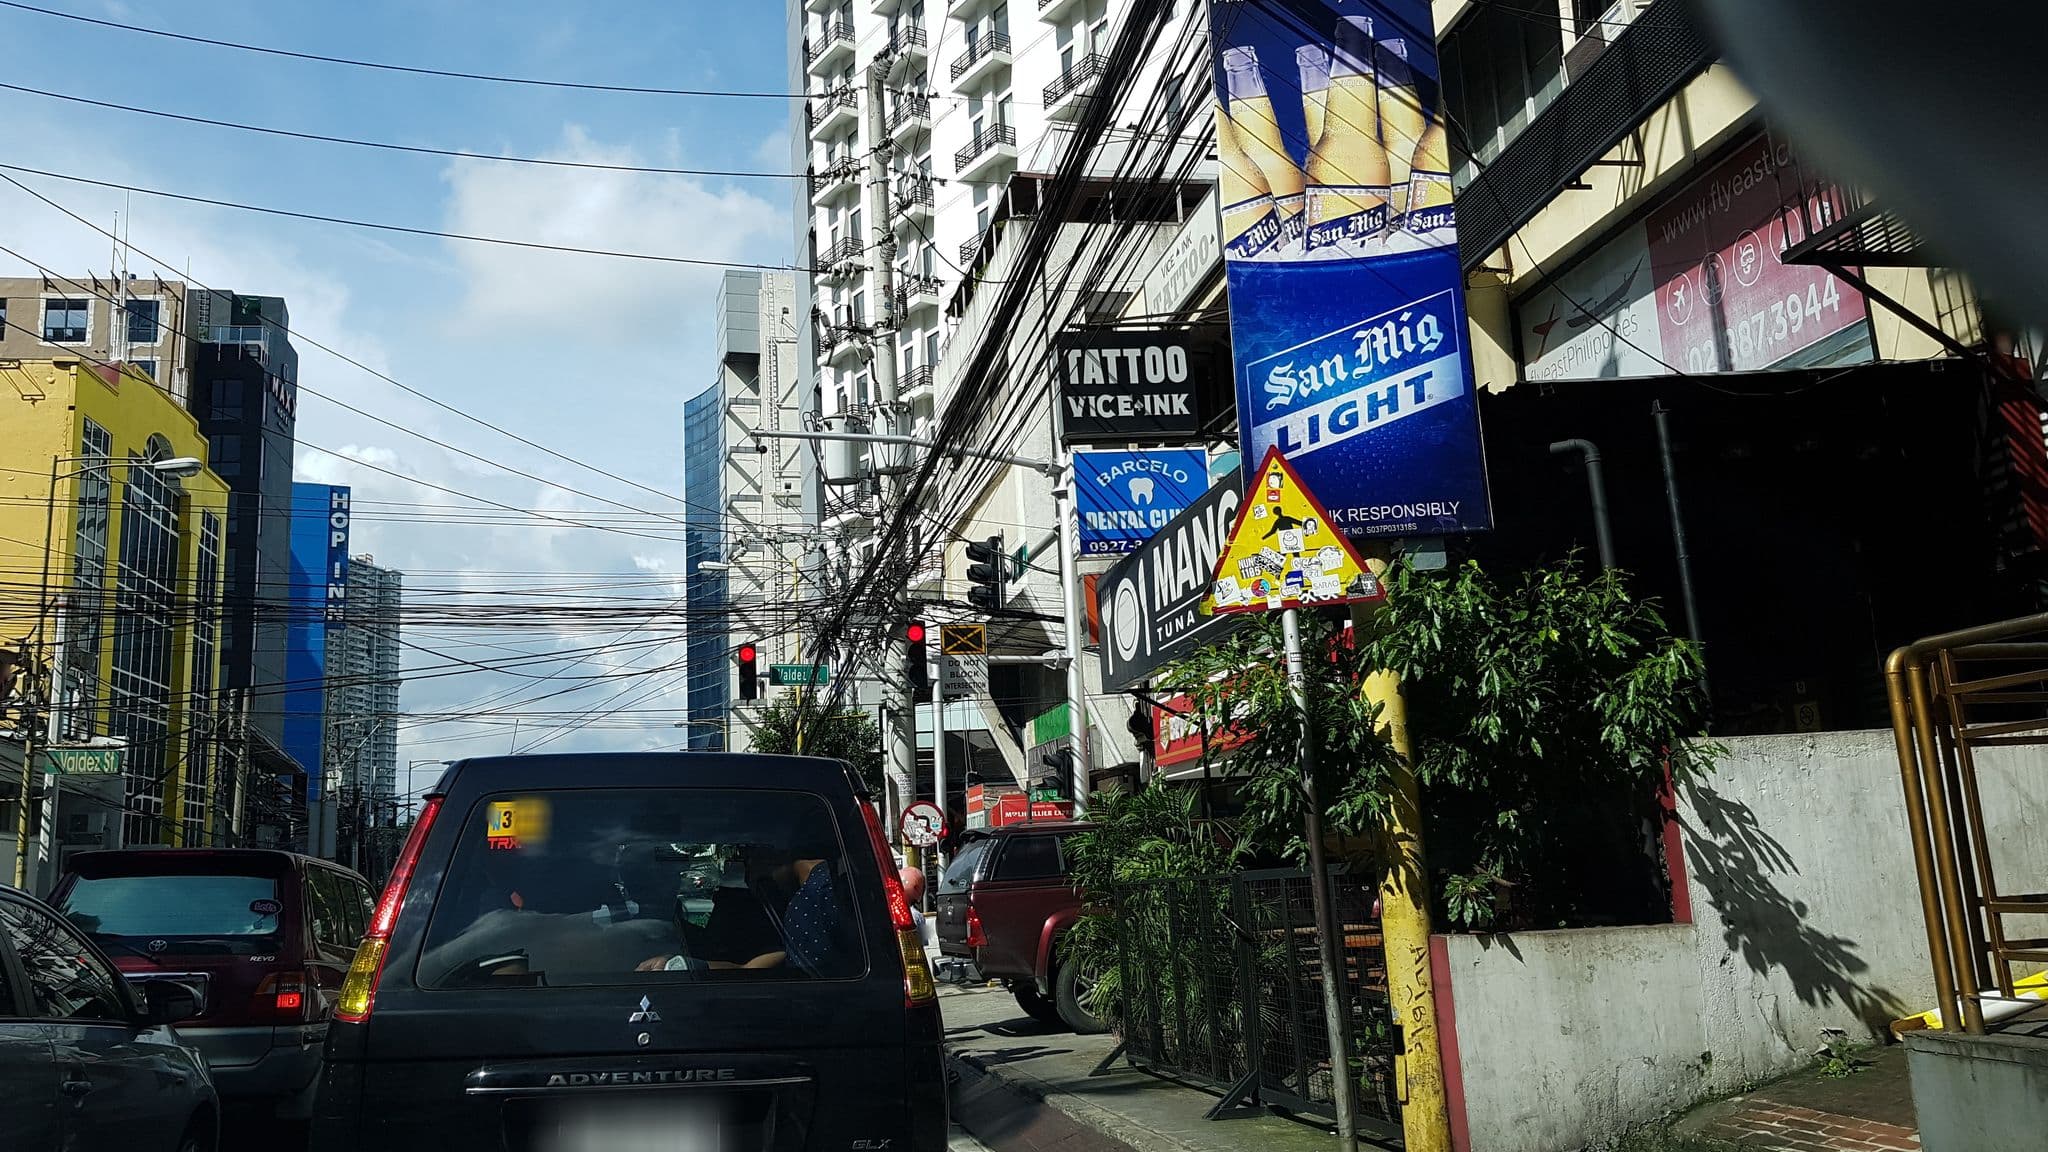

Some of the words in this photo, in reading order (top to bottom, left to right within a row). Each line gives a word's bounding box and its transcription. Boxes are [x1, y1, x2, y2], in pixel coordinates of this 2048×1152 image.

[1309, 227, 1345, 248] San
[1347, 210, 1383, 238] Mig
[1410, 212, 1445, 231] San
[1153, 235, 1209, 313] TATTOO
[1064, 345, 1188, 385] TATTOO
[1264, 353, 1349, 411] San
[1352, 311, 1444, 379] Mig
[1067, 394, 1135, 418] VICE
[1143, 393, 1191, 416] INK
[1276, 370, 1434, 452] LIGHT
[1096, 459, 1189, 487] BARCELO
[331, 491, 349, 548] HOP
[1086, 510, 1148, 531] DENTAL
[1149, 508, 1185, 528] CLI
[1348, 501, 1460, 521] RESPONSIBLY
[1156, 610, 1195, 642] TUNA
[777, 668, 807, 680] Valdez
[60, 751, 100, 772] Valdez
[103, 751, 118, 772] St.
[547, 1067, 736, 1086] ADVENTURE
